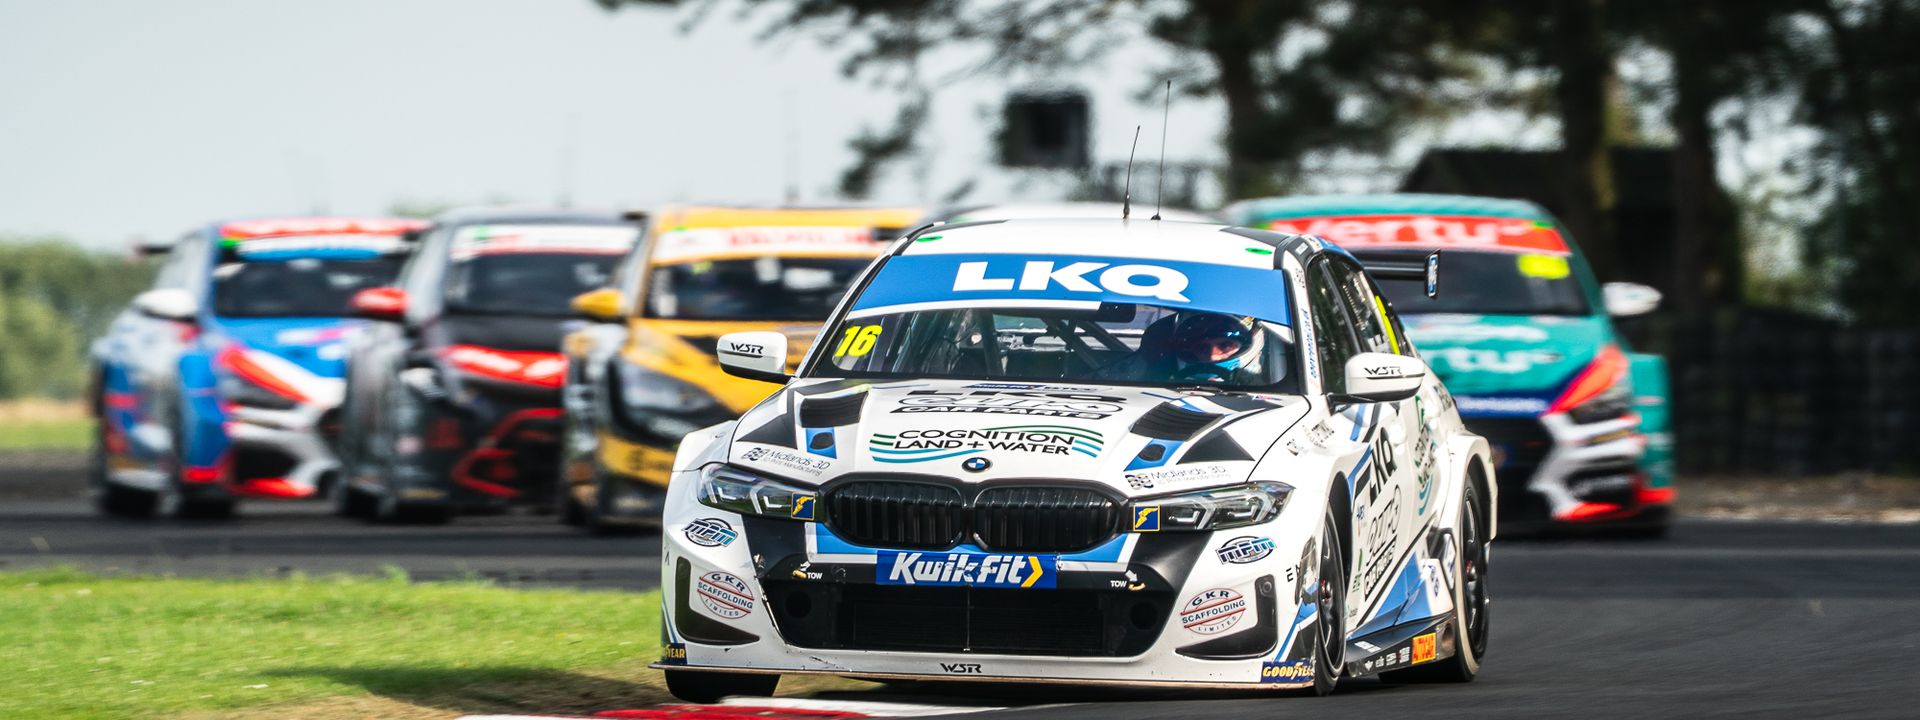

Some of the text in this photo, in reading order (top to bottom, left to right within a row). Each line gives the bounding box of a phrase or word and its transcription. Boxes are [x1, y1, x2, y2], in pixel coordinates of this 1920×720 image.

[952, 261, 1191, 302] LKQ
[730, 343, 763, 354] WSR
[835, 325, 882, 357] 16
[898, 430, 1075, 445] COGNITION
[1151, 467, 1207, 480] Midlands
[1111, 580, 1127, 588] TOW
[698, 582, 754, 610] SCAFFOLDING
[704, 598, 739, 617] LIMITED
[1181, 600, 1246, 624] SCAFFOLDING
[1197, 616, 1237, 632] LIMITED
[939, 663, 982, 673] WSR
